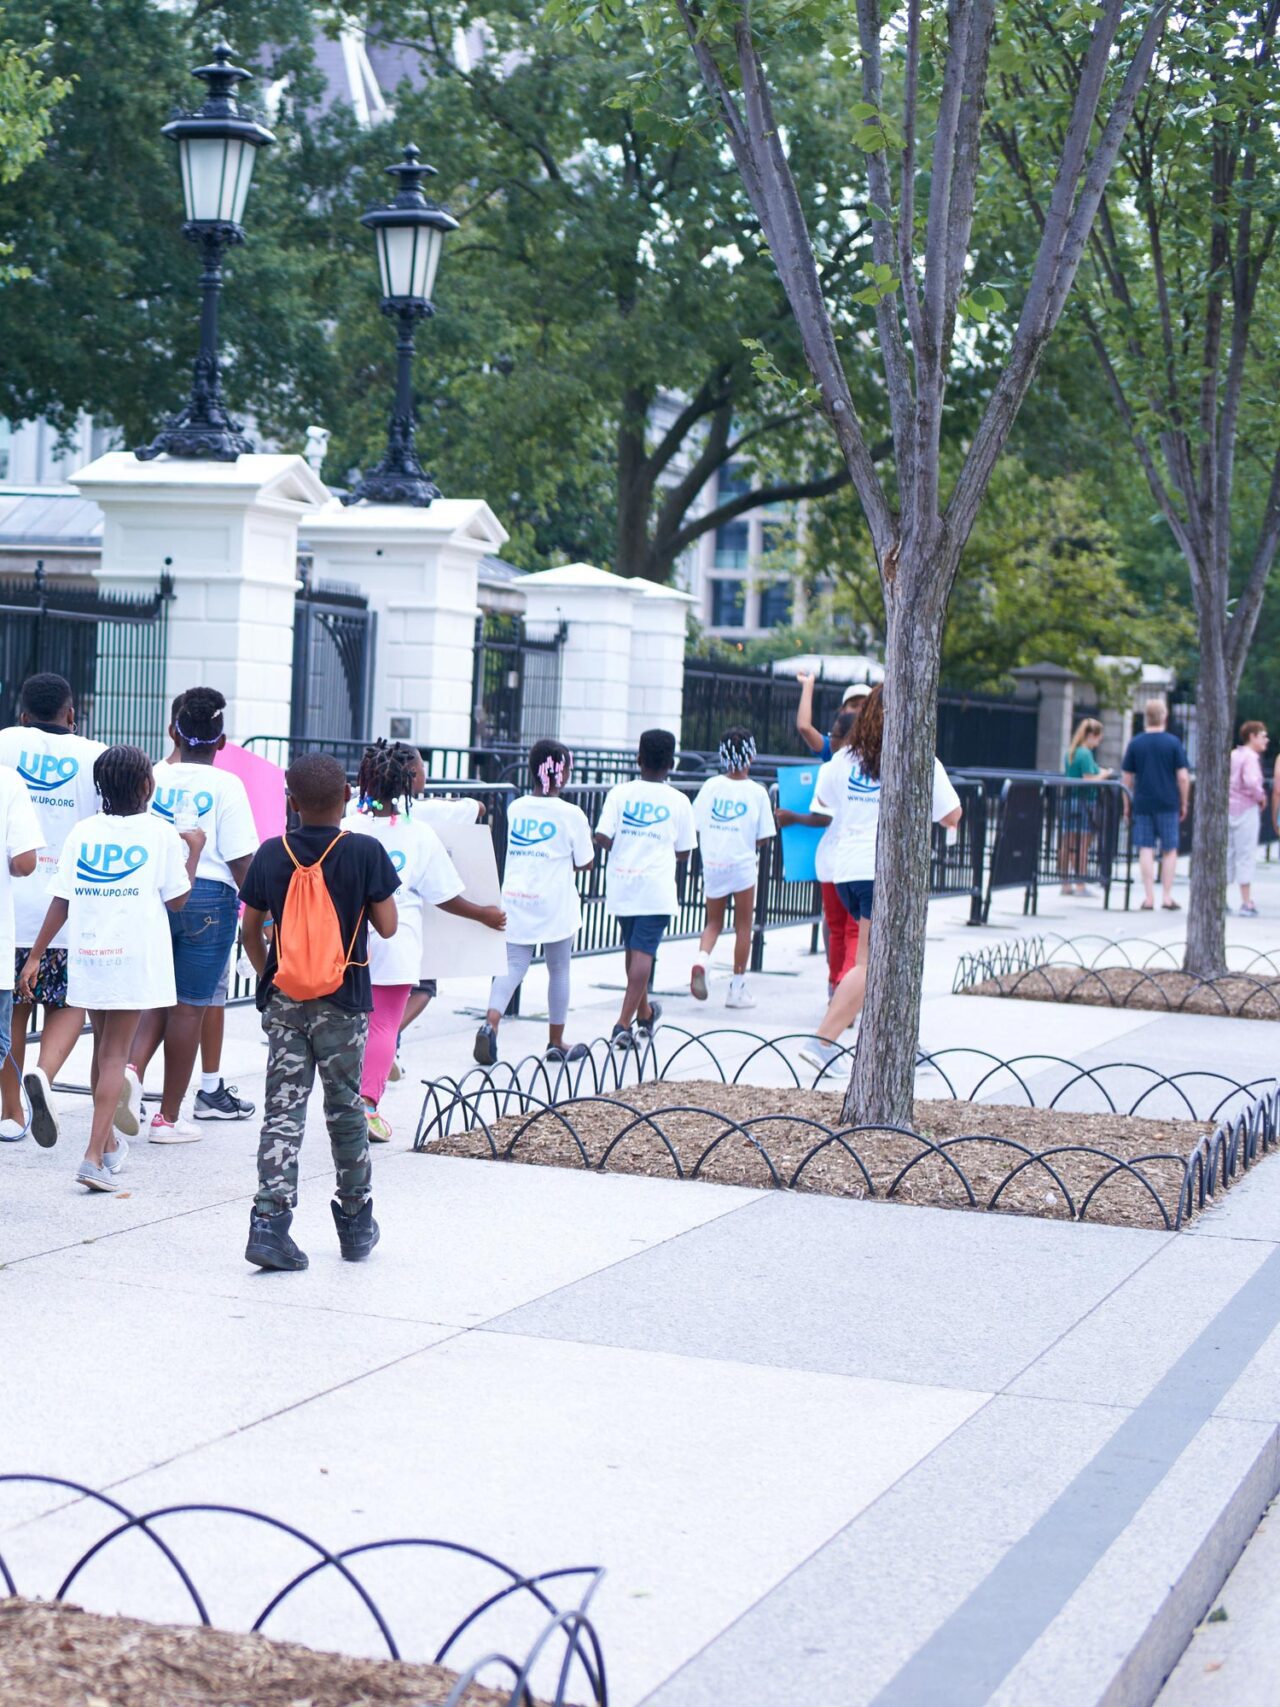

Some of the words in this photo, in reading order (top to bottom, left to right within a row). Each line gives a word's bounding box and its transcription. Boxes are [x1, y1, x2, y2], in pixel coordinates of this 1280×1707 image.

[20, 751, 79, 780] UPO
[625, 800, 670, 820] UPO
[714, 797, 747, 816] UPO
[513, 818, 556, 838] UPO
[81, 843, 148, 871] UPO
[74, 887, 139, 897] WWW.UPO.ORG
